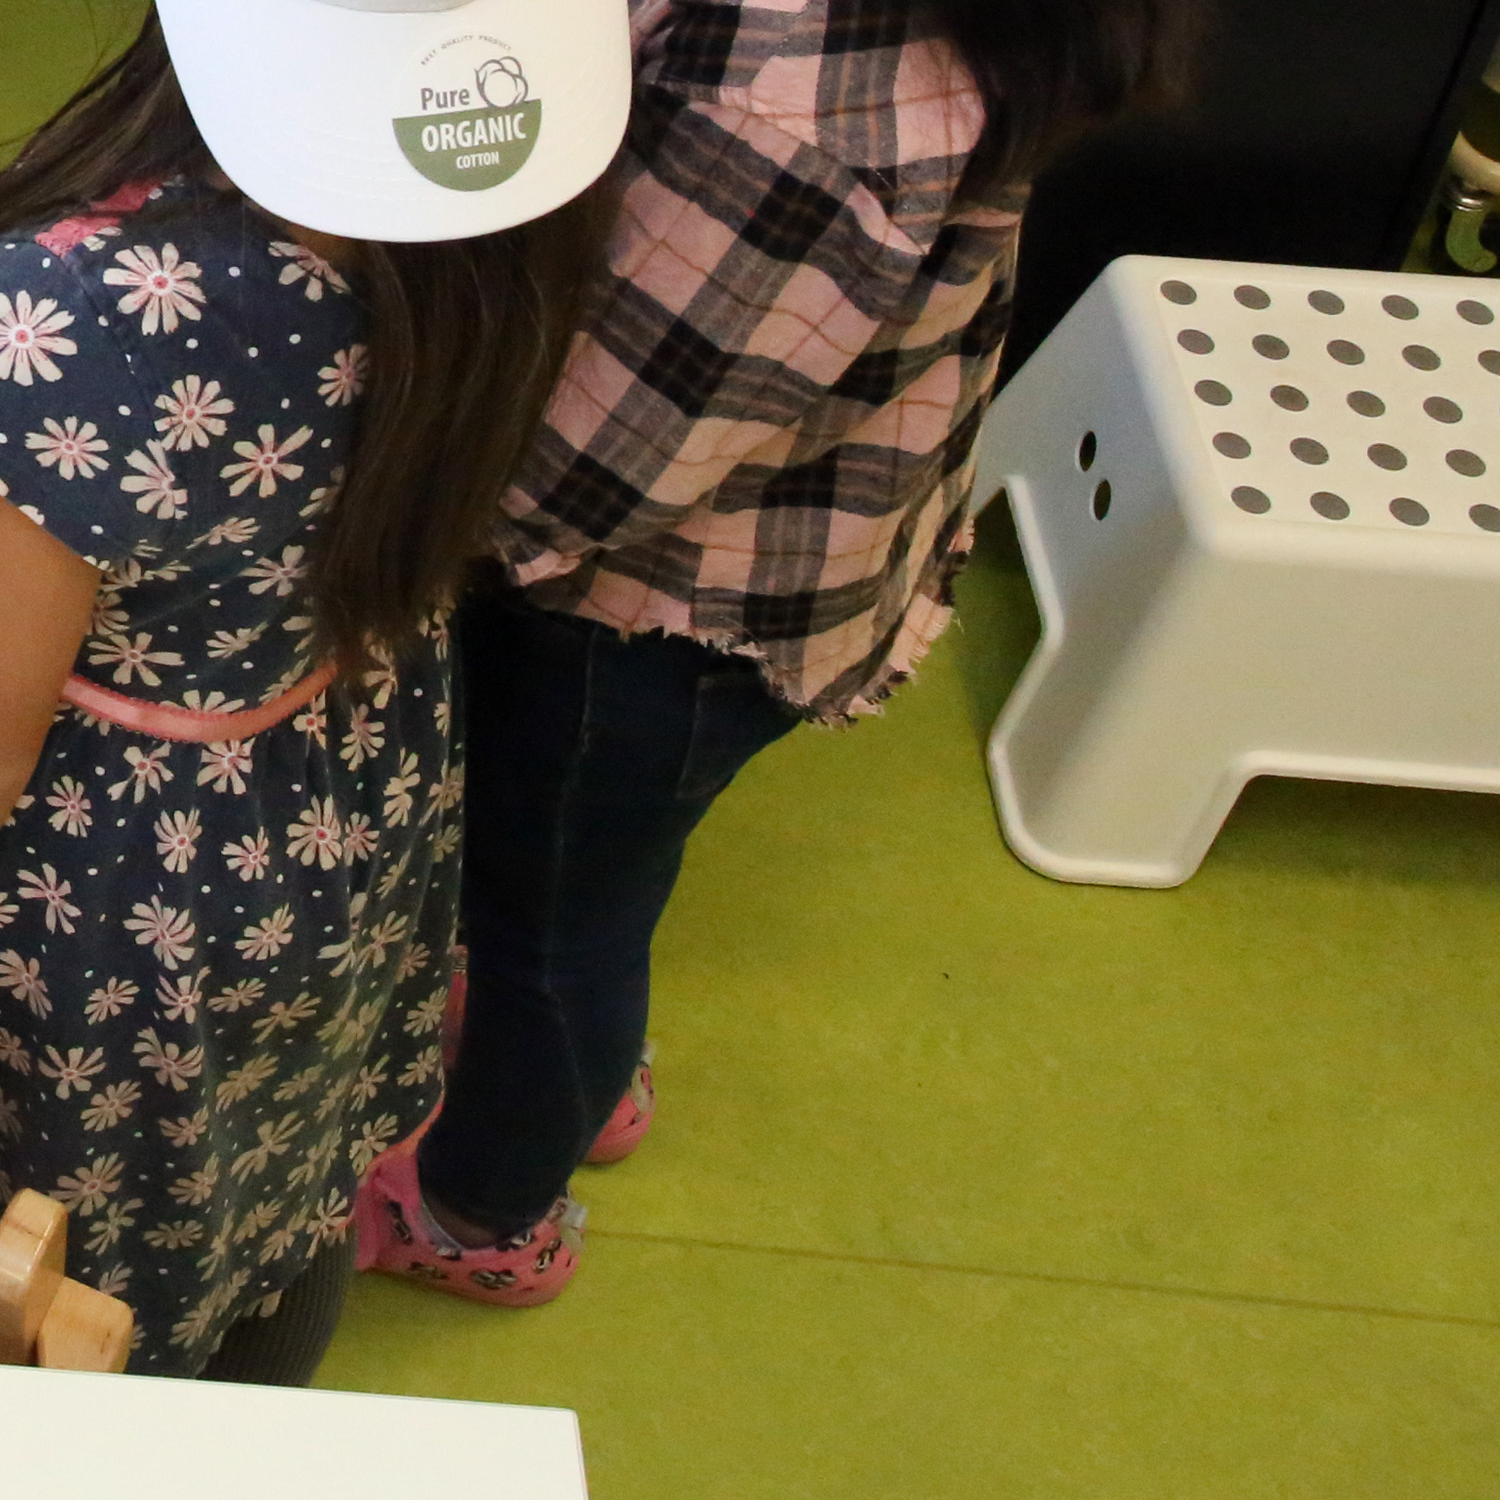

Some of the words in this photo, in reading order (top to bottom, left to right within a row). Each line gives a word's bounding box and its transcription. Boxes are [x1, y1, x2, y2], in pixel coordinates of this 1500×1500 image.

[421, 87, 470, 110] Pure
[421, 112, 527, 152] ORGANIC
[456, 151, 500, 169] COTTON
